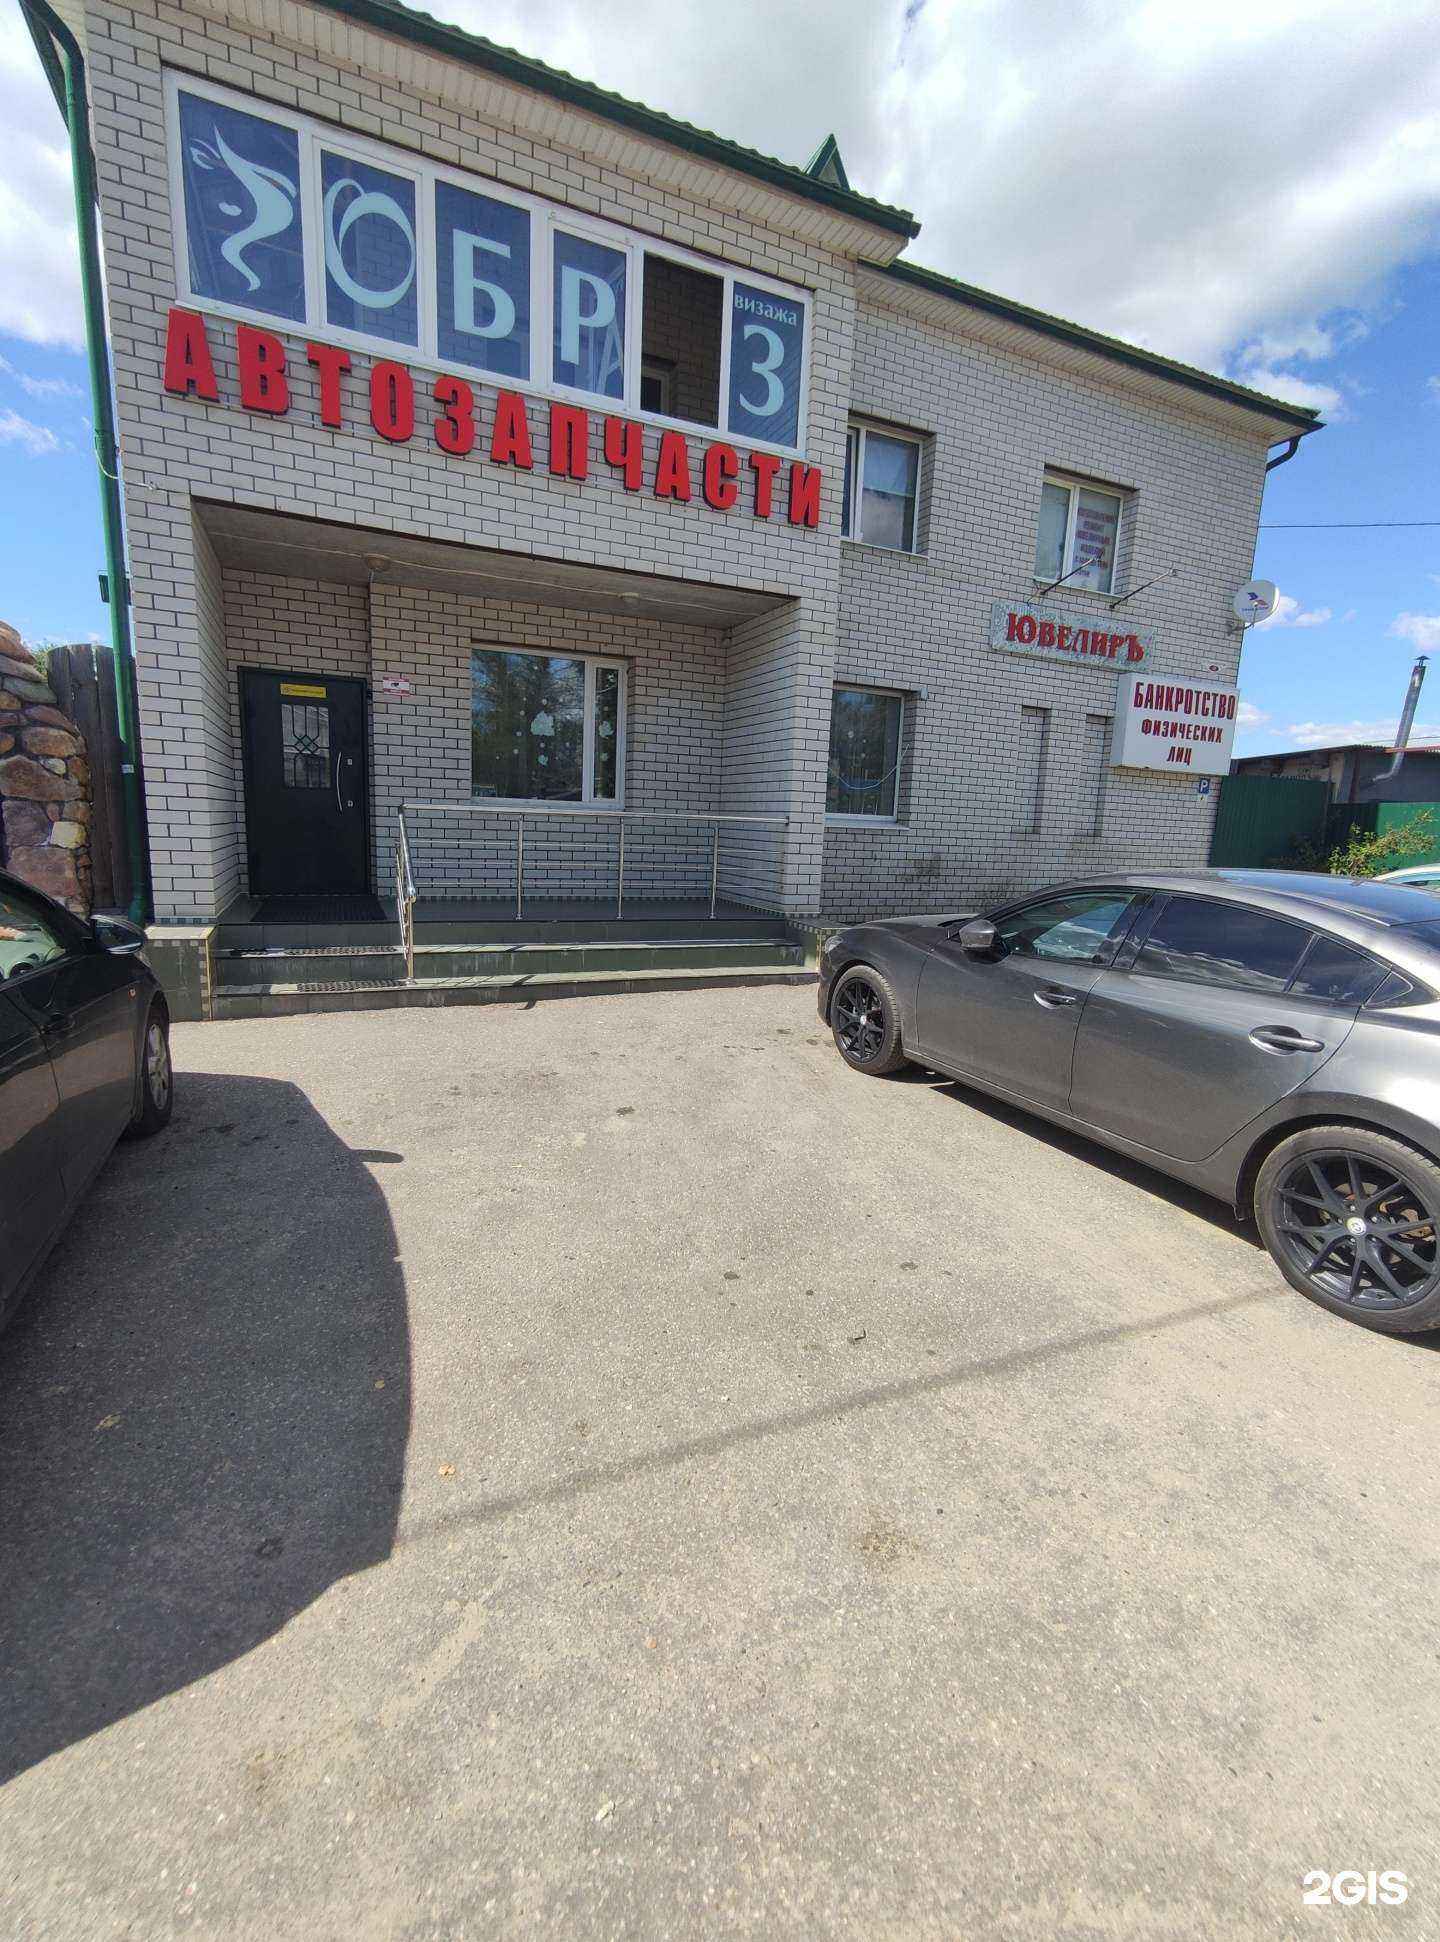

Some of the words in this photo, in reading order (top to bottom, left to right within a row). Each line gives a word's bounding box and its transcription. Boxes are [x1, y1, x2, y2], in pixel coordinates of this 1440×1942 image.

[734, 294, 797, 327] визажа
[164, 306, 822, 528] АВТОЗАПЧАСТИ
[1006, 612, 1145, 662] ЮВЕЛИРЪ
[1133, 681, 1236, 720] БАНКРОТСТВО
[1141, 718, 1223, 744] ФИЗИЧЕСКИХ
[1166, 745, 1192, 766] ЛИЦ
